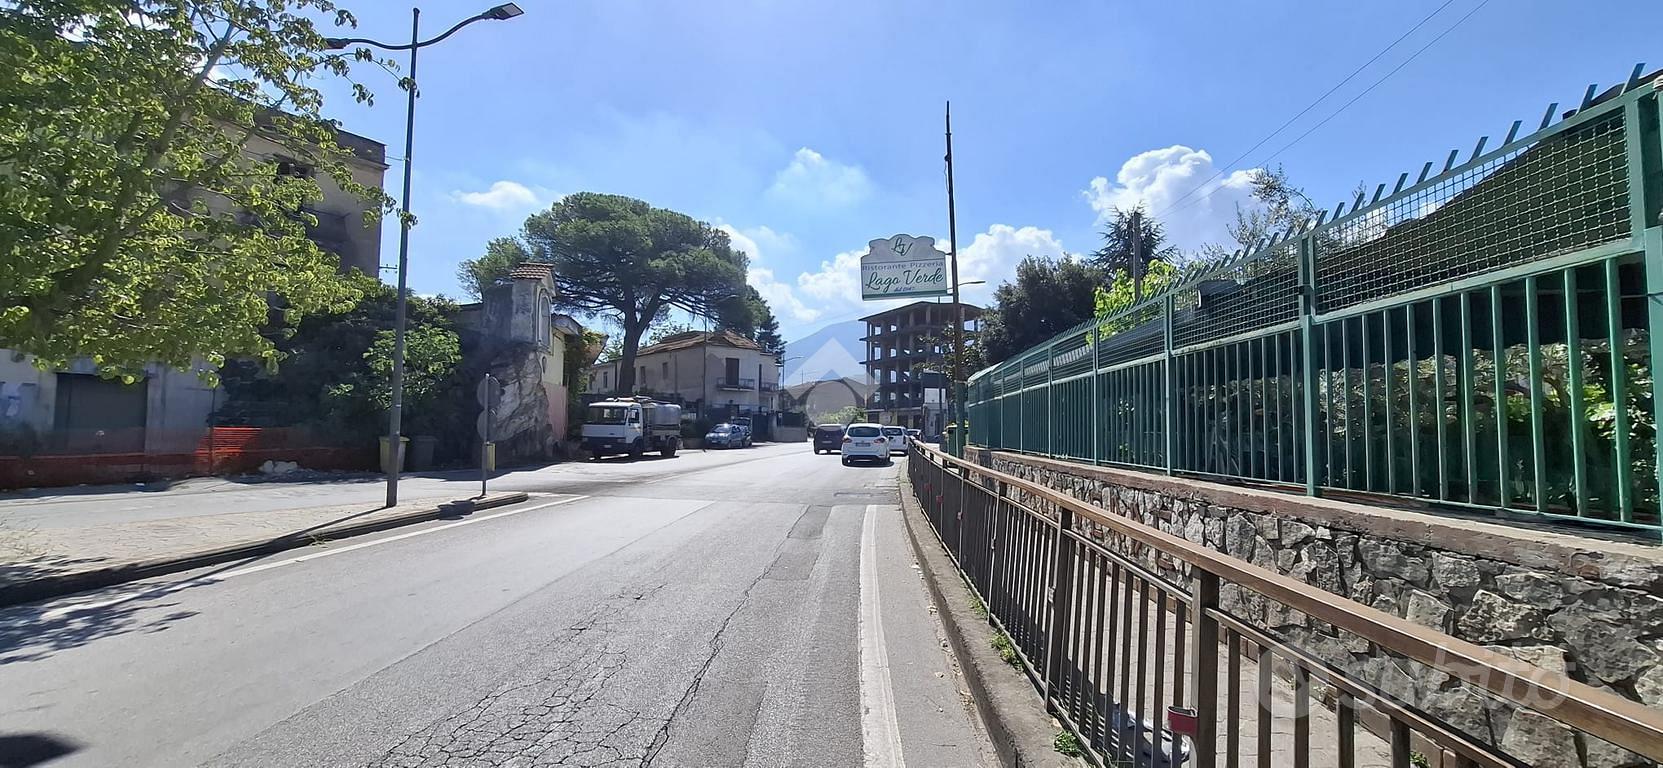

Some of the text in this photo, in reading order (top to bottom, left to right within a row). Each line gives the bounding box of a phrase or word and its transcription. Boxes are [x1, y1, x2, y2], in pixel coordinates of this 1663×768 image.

[862, 263, 907, 271] Ristorante
[865, 267, 944, 293] Lago Verde
